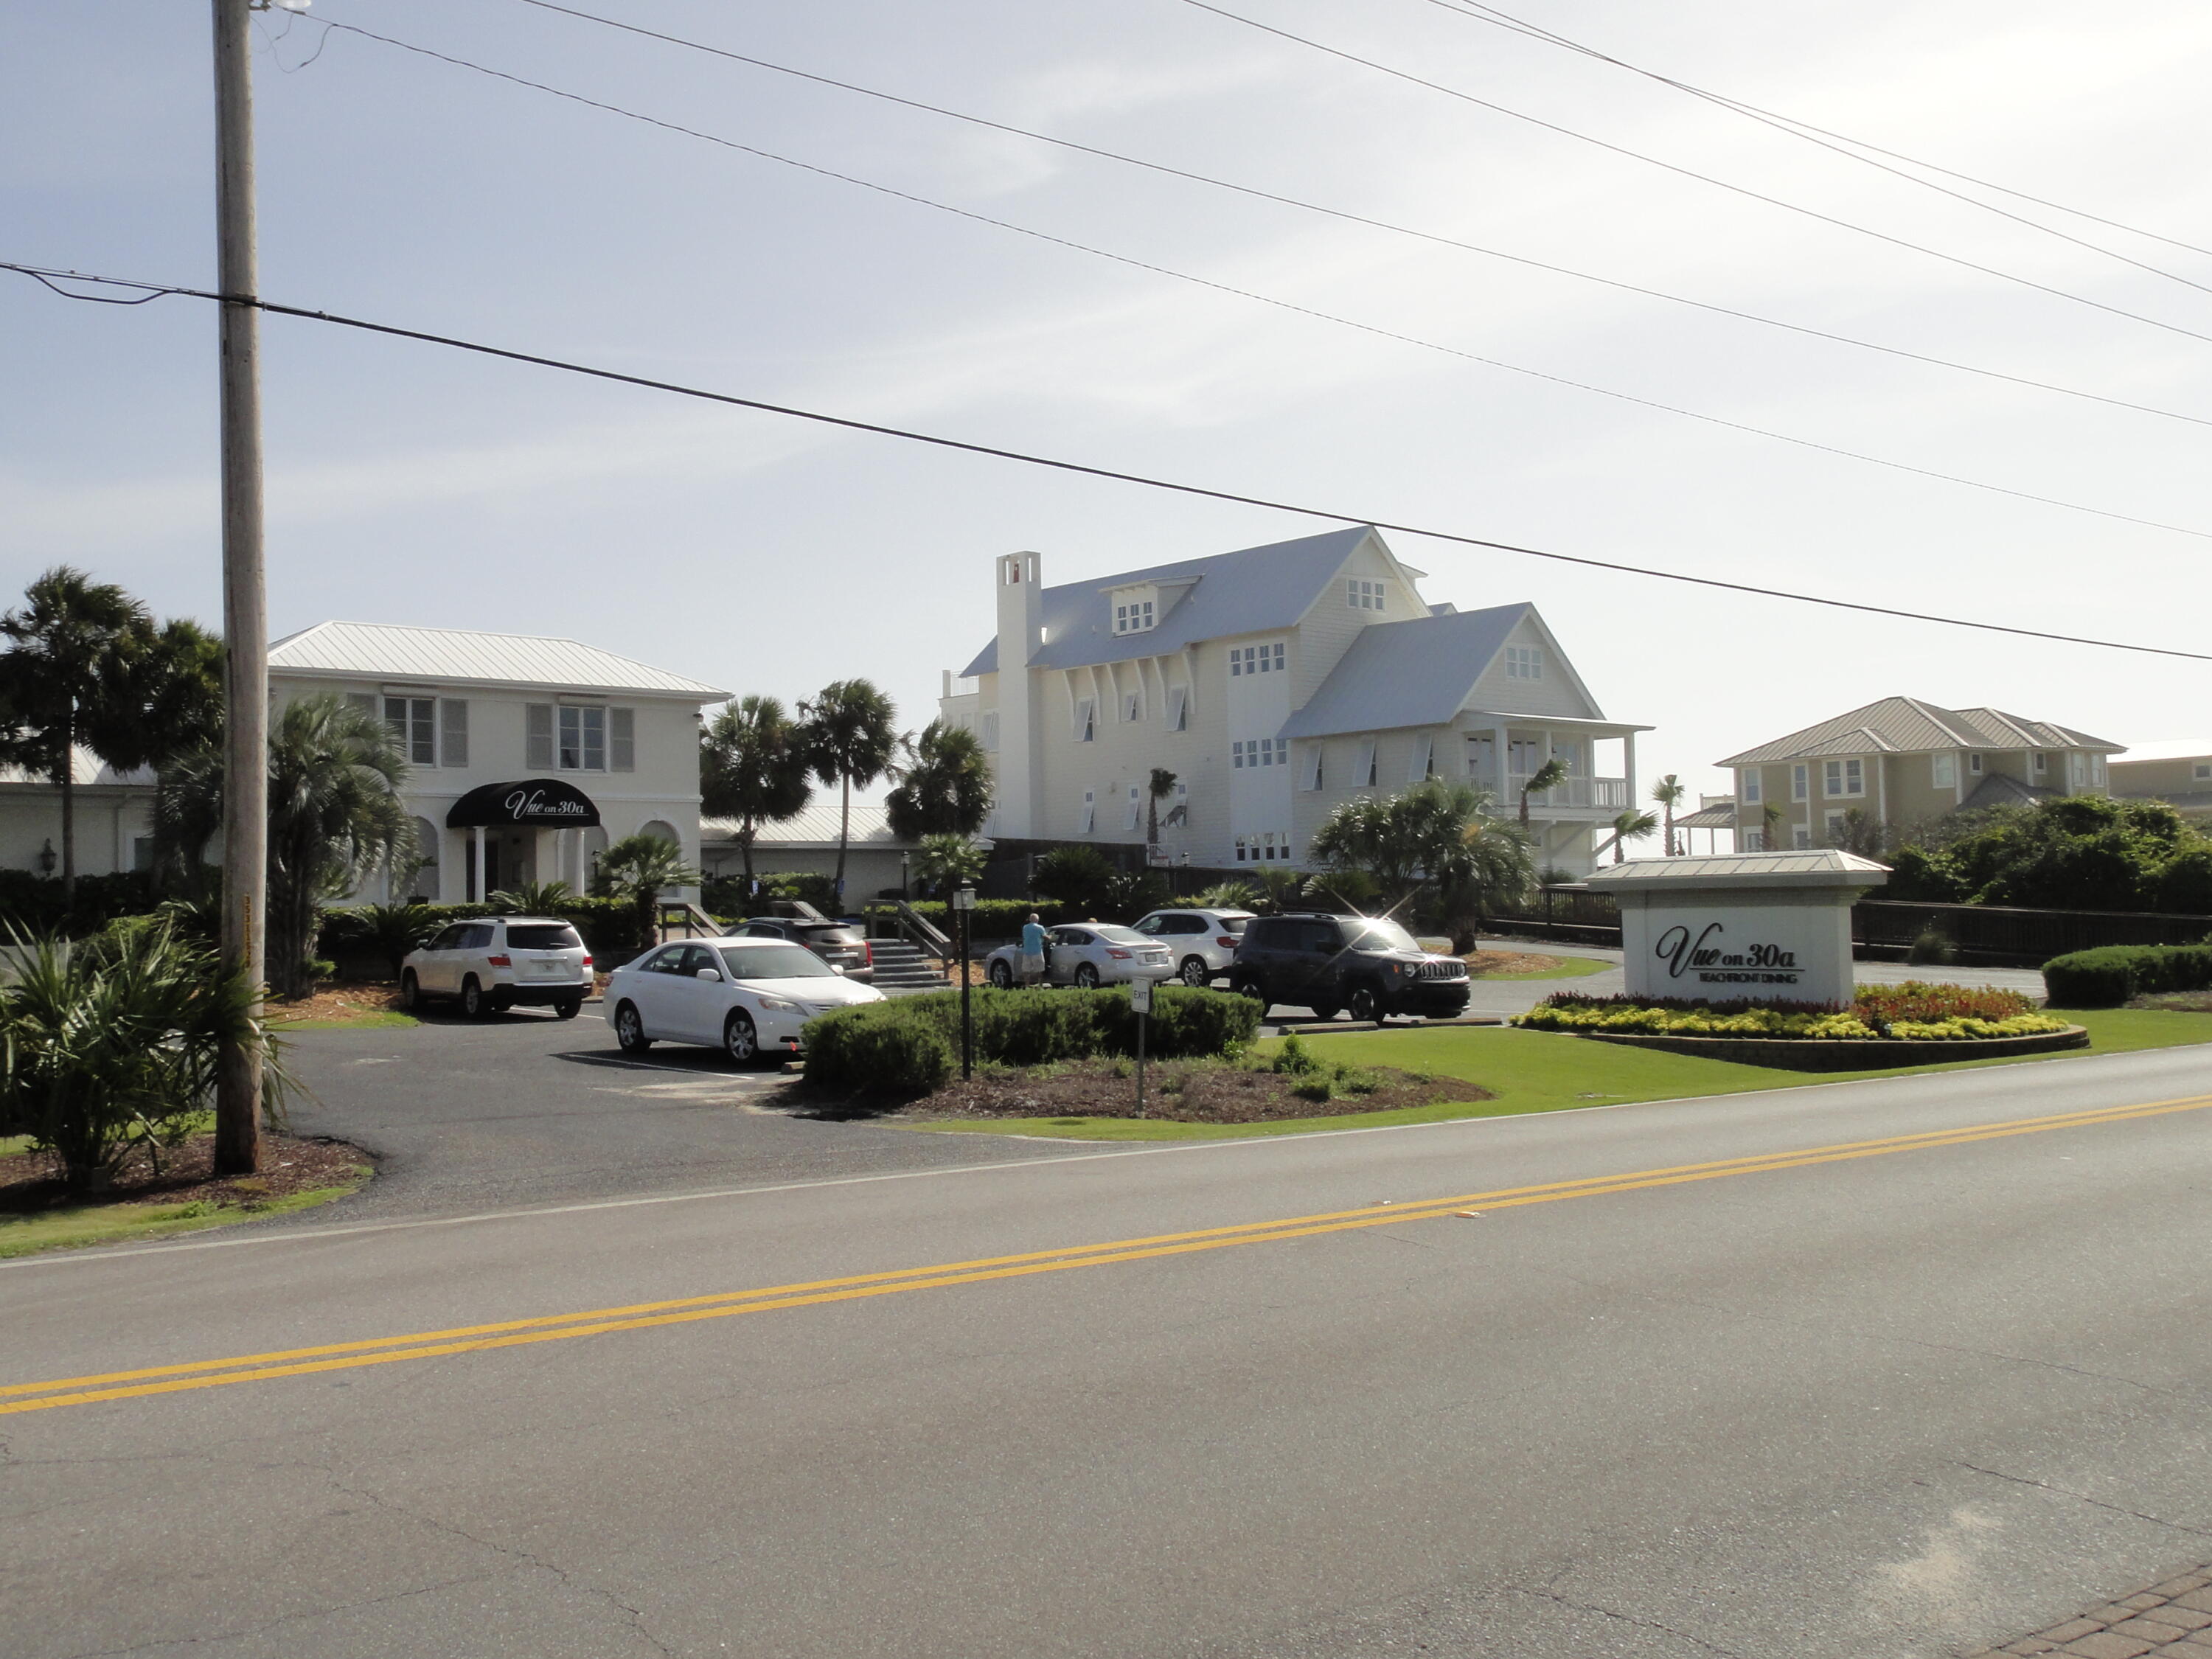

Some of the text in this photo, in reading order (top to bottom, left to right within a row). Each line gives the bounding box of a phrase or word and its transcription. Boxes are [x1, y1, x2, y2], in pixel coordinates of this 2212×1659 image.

[505, 790, 545, 819] Vue
[558, 801, 584, 813] 30a
[1655, 922, 1795, 978] Vue on 30a
[1699, 973, 1798, 984] BEACHFRONT DINING
[1134, 990, 1147, 1000] EXIT
